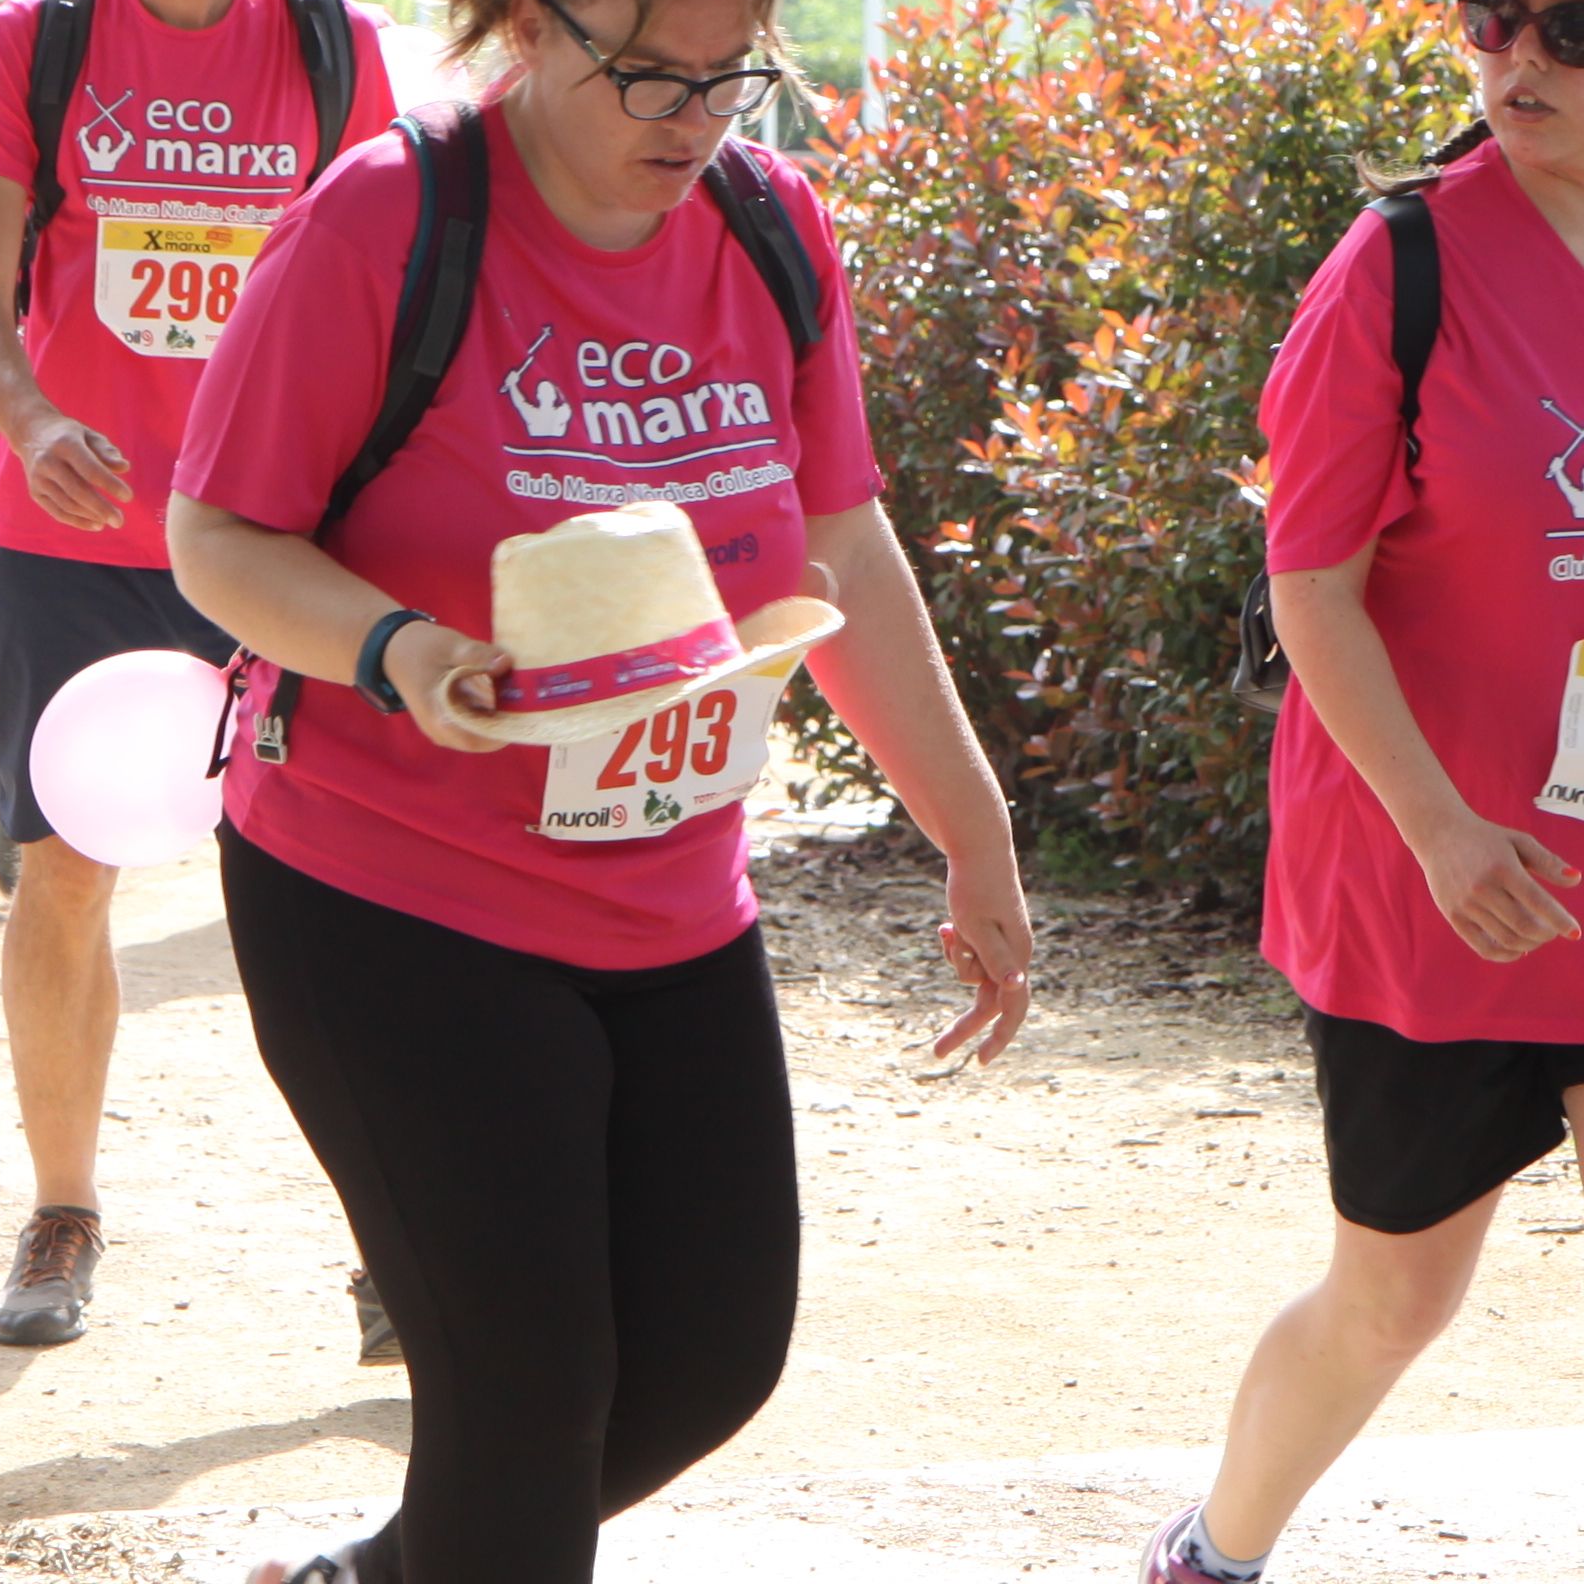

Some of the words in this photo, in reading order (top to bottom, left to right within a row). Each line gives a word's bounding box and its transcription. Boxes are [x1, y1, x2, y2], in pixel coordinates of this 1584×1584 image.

[146, 98, 232, 134] eco
[146, 138, 297, 177] marxa
[109, 197, 160, 217] Marxa
[143, 230, 163, 251] X
[165, 241, 211, 254] marxa
[129, 258, 240, 324] 298
[577, 340, 693, 388] eco
[582, 381, 771, 446] marxa
[507, 470, 562, 500] Club
[563, 475, 625, 506] Marxa
[596, 689, 737, 791] 293
[547, 806, 610, 827] nuroil
